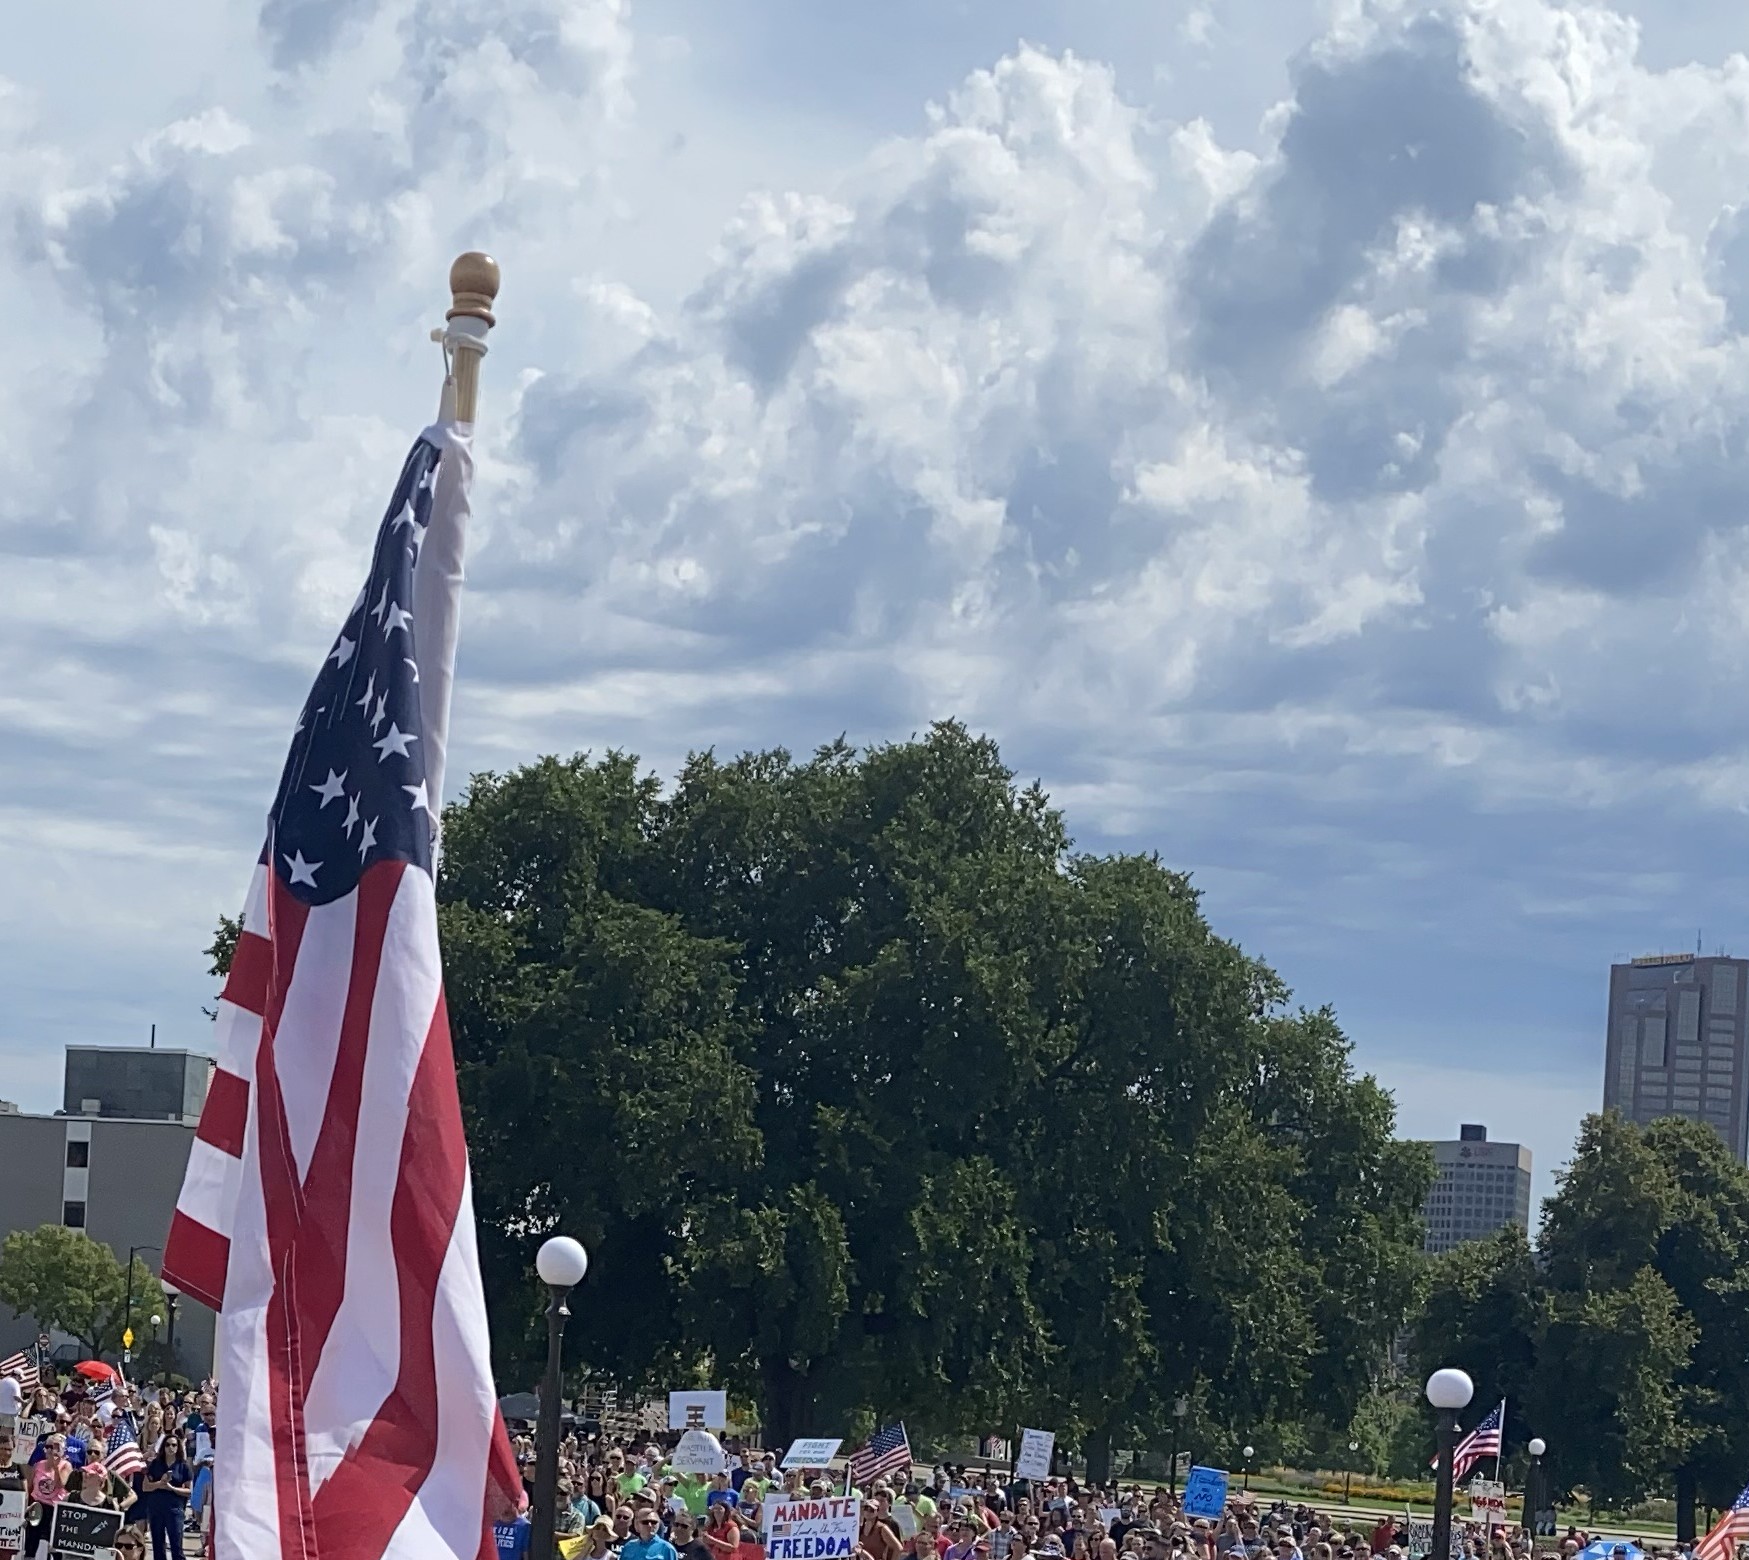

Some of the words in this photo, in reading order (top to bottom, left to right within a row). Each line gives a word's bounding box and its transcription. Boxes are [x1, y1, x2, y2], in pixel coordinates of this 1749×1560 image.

[62, 1510, 88, 1520] STOP
[774, 1499, 856, 1522] MANDATE
[61, 1525, 79, 1535] THE
[58, 1539, 103, 1551] MANDA
[769, 1535, 852, 1560] FREEDOM
